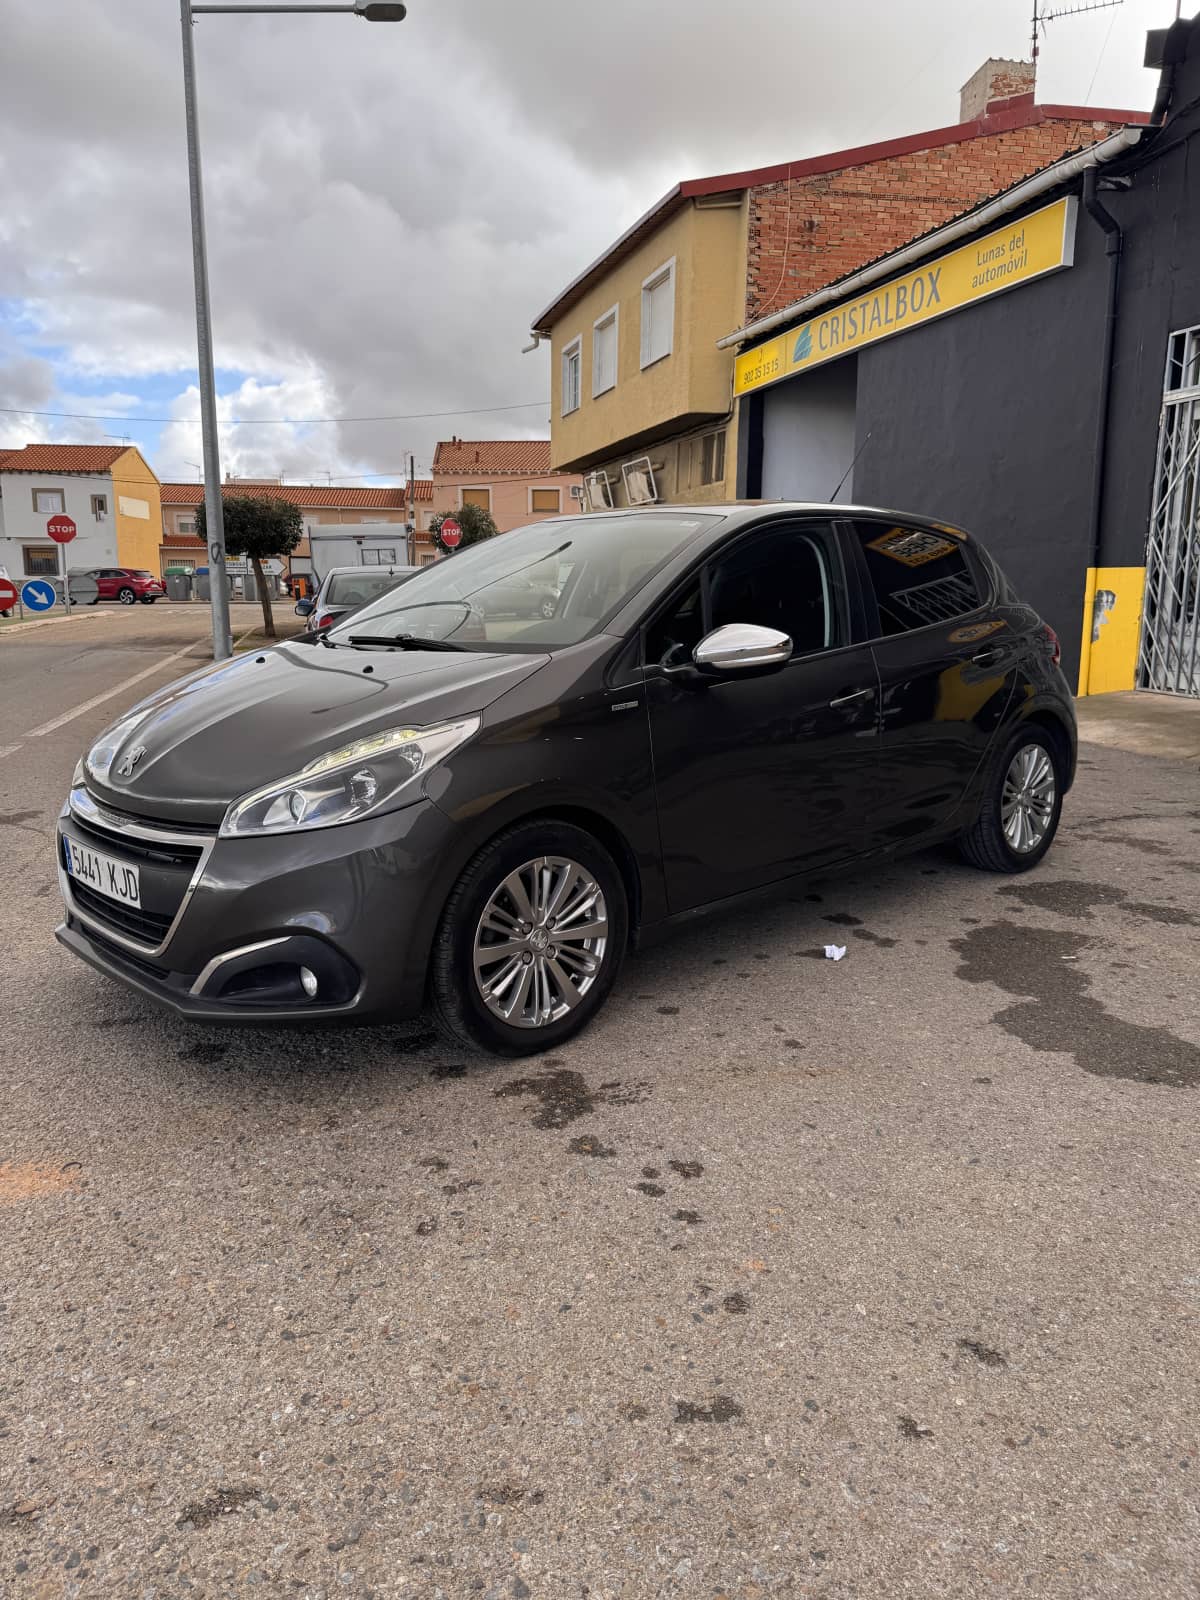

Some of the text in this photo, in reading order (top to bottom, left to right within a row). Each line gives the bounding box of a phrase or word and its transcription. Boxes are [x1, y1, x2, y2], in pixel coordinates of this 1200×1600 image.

[977, 228, 1025, 266] Lunas del
[971, 248, 1028, 288] automóvil
[819, 267, 942, 351] CRISTALBOX
[763, 361, 770, 376] 15
[771, 359, 778, 372] 15
[49, 525, 75, 533] STOP
[443, 528, 460, 536] STOP
[71, 844, 102, 887] 5441
